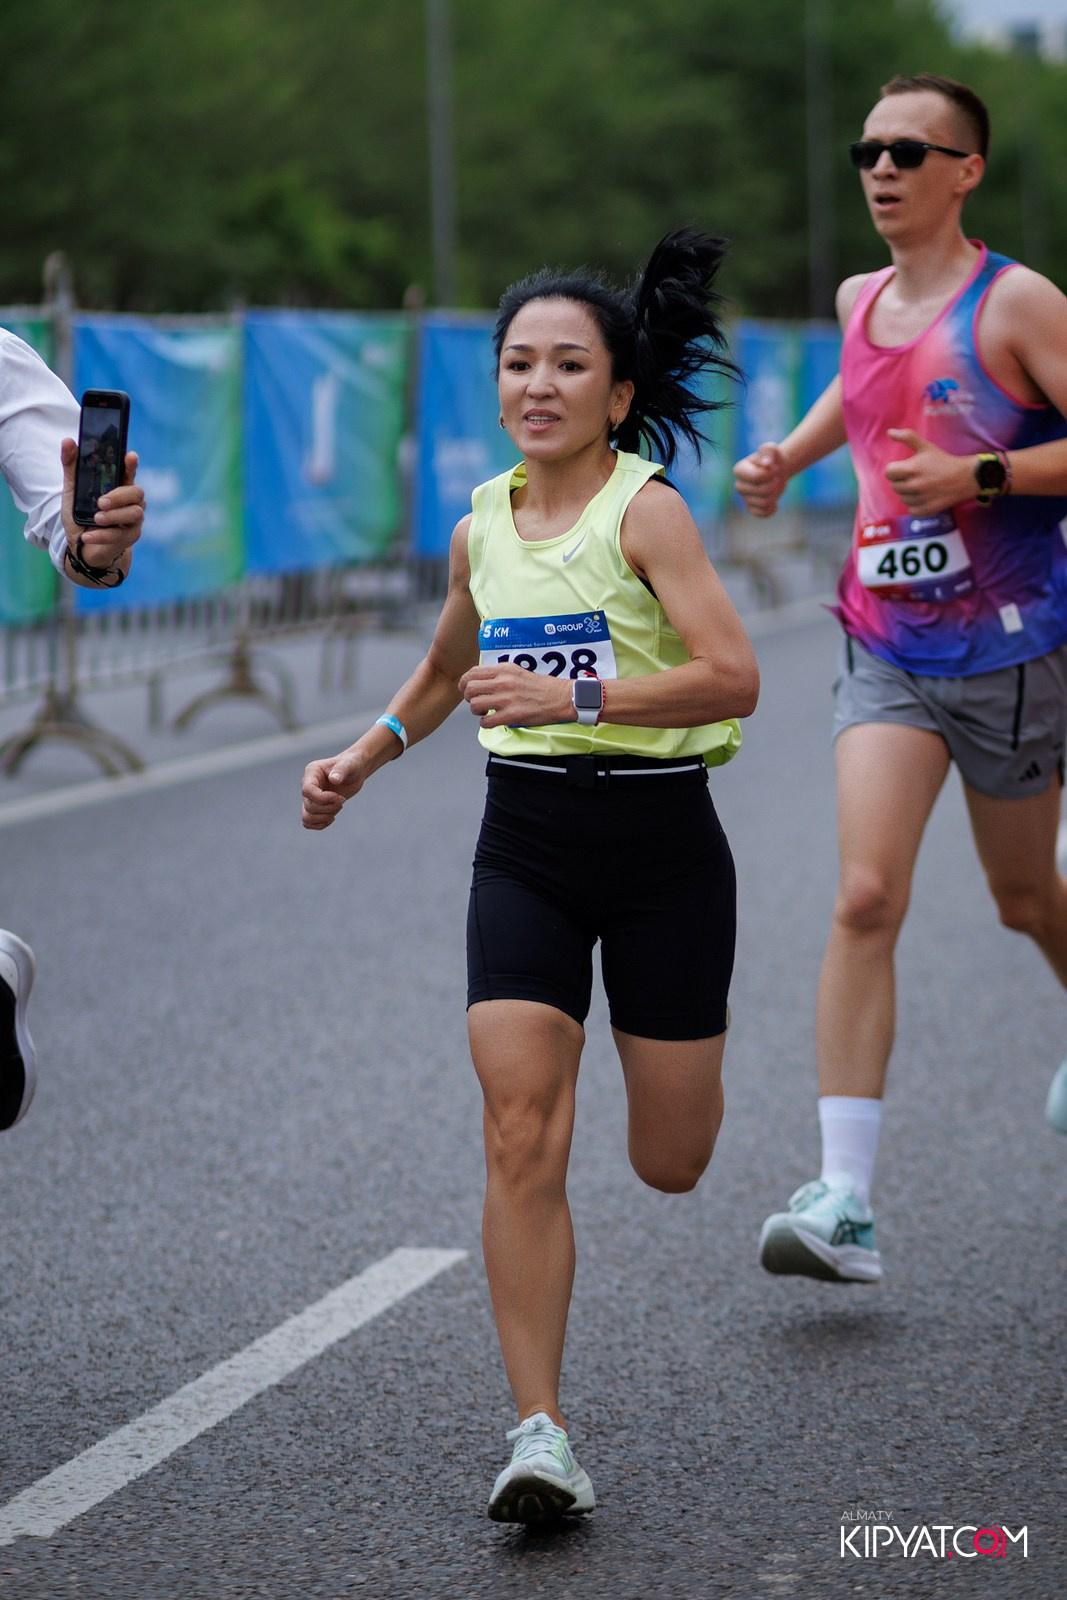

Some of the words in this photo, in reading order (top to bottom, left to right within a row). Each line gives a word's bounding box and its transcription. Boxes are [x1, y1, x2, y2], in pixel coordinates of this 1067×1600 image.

[877, 542, 948, 579] 460
[483, 624, 492, 638] 5
[493, 627, 510, 638] KM
[556, 623, 584, 633] GROUP
